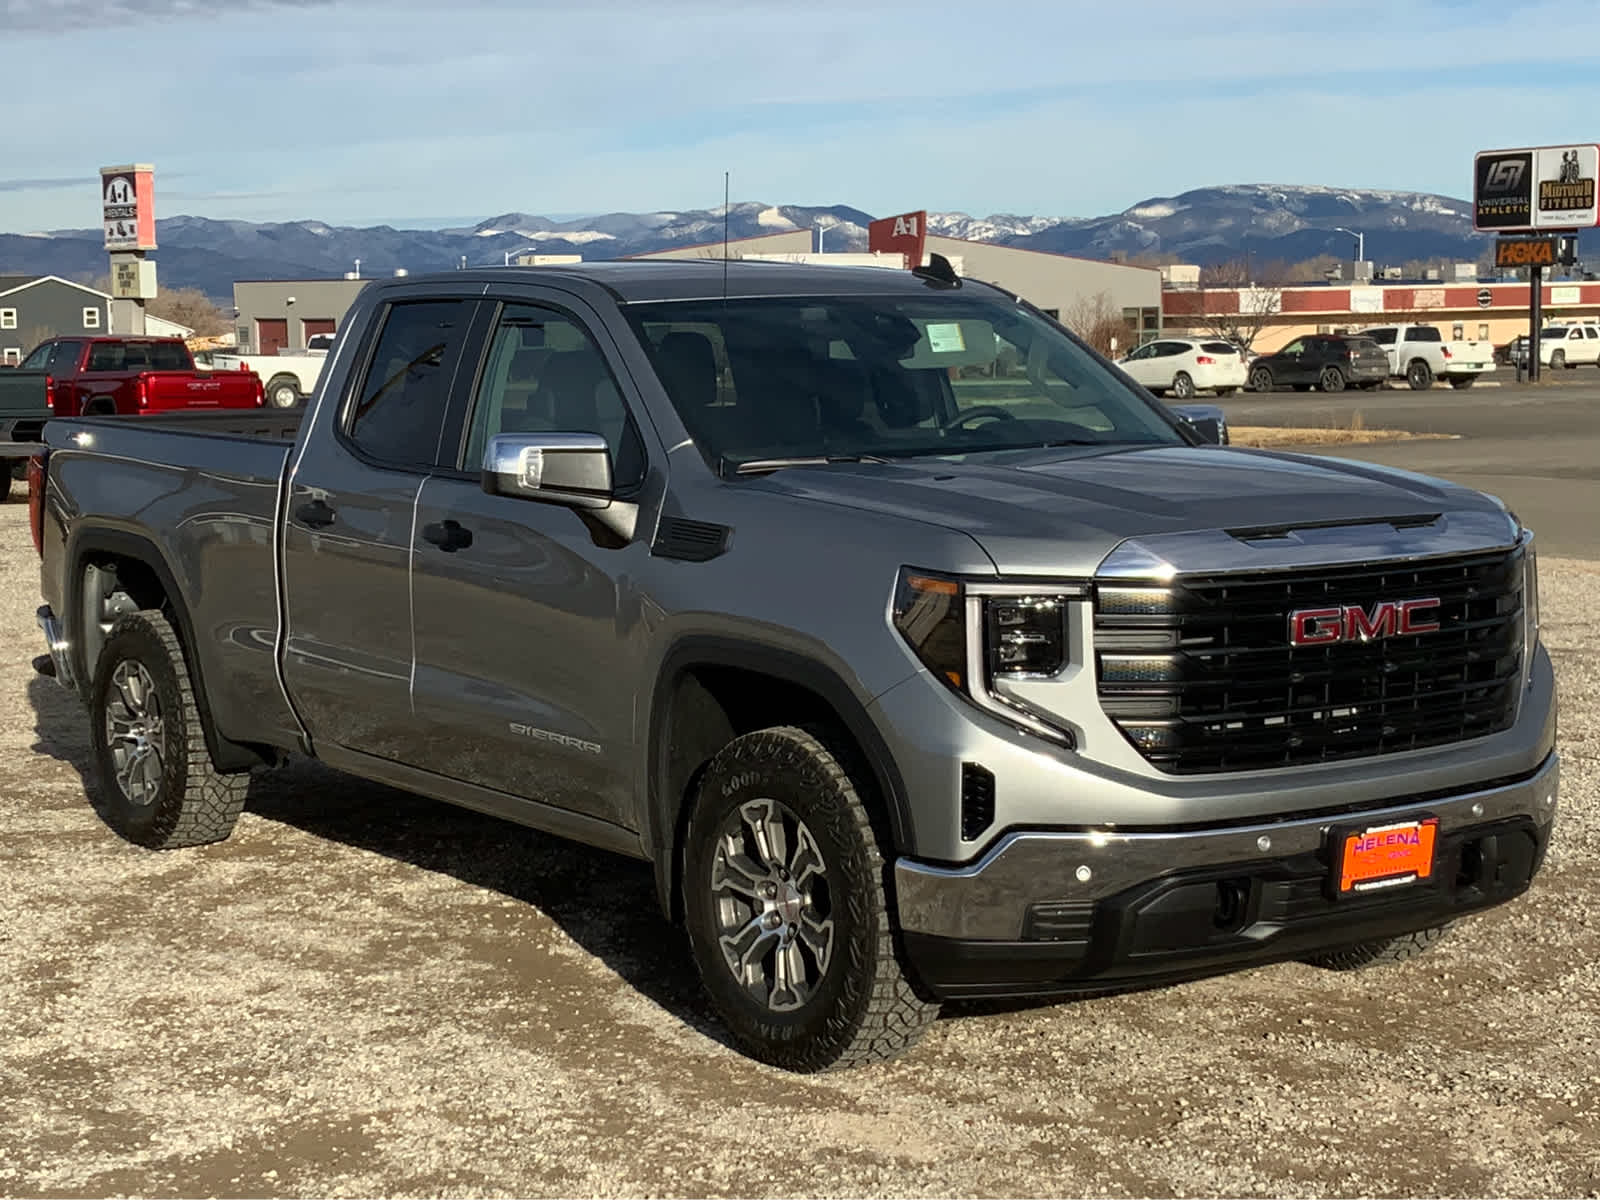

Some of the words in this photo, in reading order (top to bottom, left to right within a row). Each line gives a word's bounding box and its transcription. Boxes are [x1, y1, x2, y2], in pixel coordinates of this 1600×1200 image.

[1478, 197, 1529, 207] UNIVERSAL
[1478, 204, 1529, 215] ATHLETIC
[1540, 197, 1593, 209] FITNESS
[1498, 241, 1553, 263] HOKA
[1288, 597, 1441, 647] GMC
[509, 722, 602, 754] SIERRA
[1353, 831, 1420, 856] HELENA
